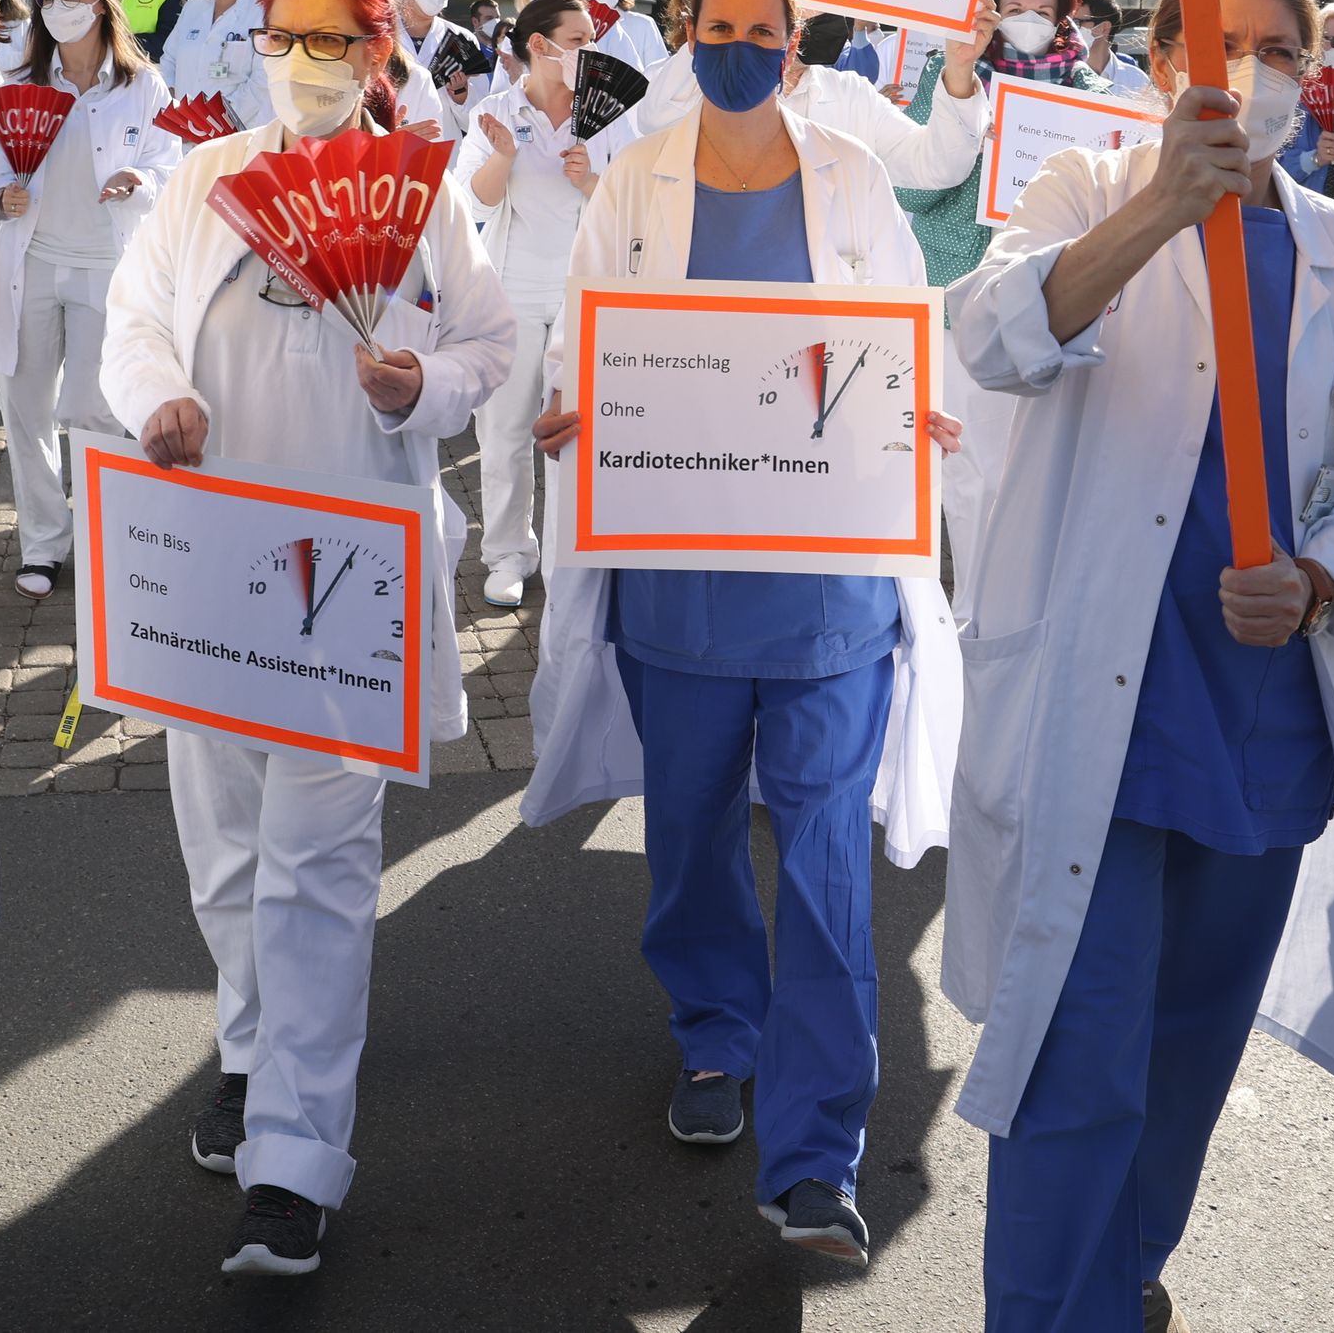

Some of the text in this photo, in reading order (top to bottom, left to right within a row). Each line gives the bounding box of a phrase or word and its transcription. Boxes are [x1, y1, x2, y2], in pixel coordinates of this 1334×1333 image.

[1018, 124, 1076, 143] Keine Stimme
[1015, 149, 1038, 162] Ohne
[602, 351, 731, 374] Kein Herzschlag
[785, 366, 799, 379] 11
[886, 374, 901, 390] 2
[758, 391, 778, 407] 10
[600, 402, 645, 418] Ohne
[902, 411, 915, 429] 3
[128, 524, 191, 553] Kein Biss
[273, 558, 288, 572] 11
[129, 573, 168, 596] Ohne
[248, 581, 267, 595] 10
[374, 580, 390, 596] 2
[391, 620, 404, 639] 3
[130, 621, 241, 663] Zahnärztliche
